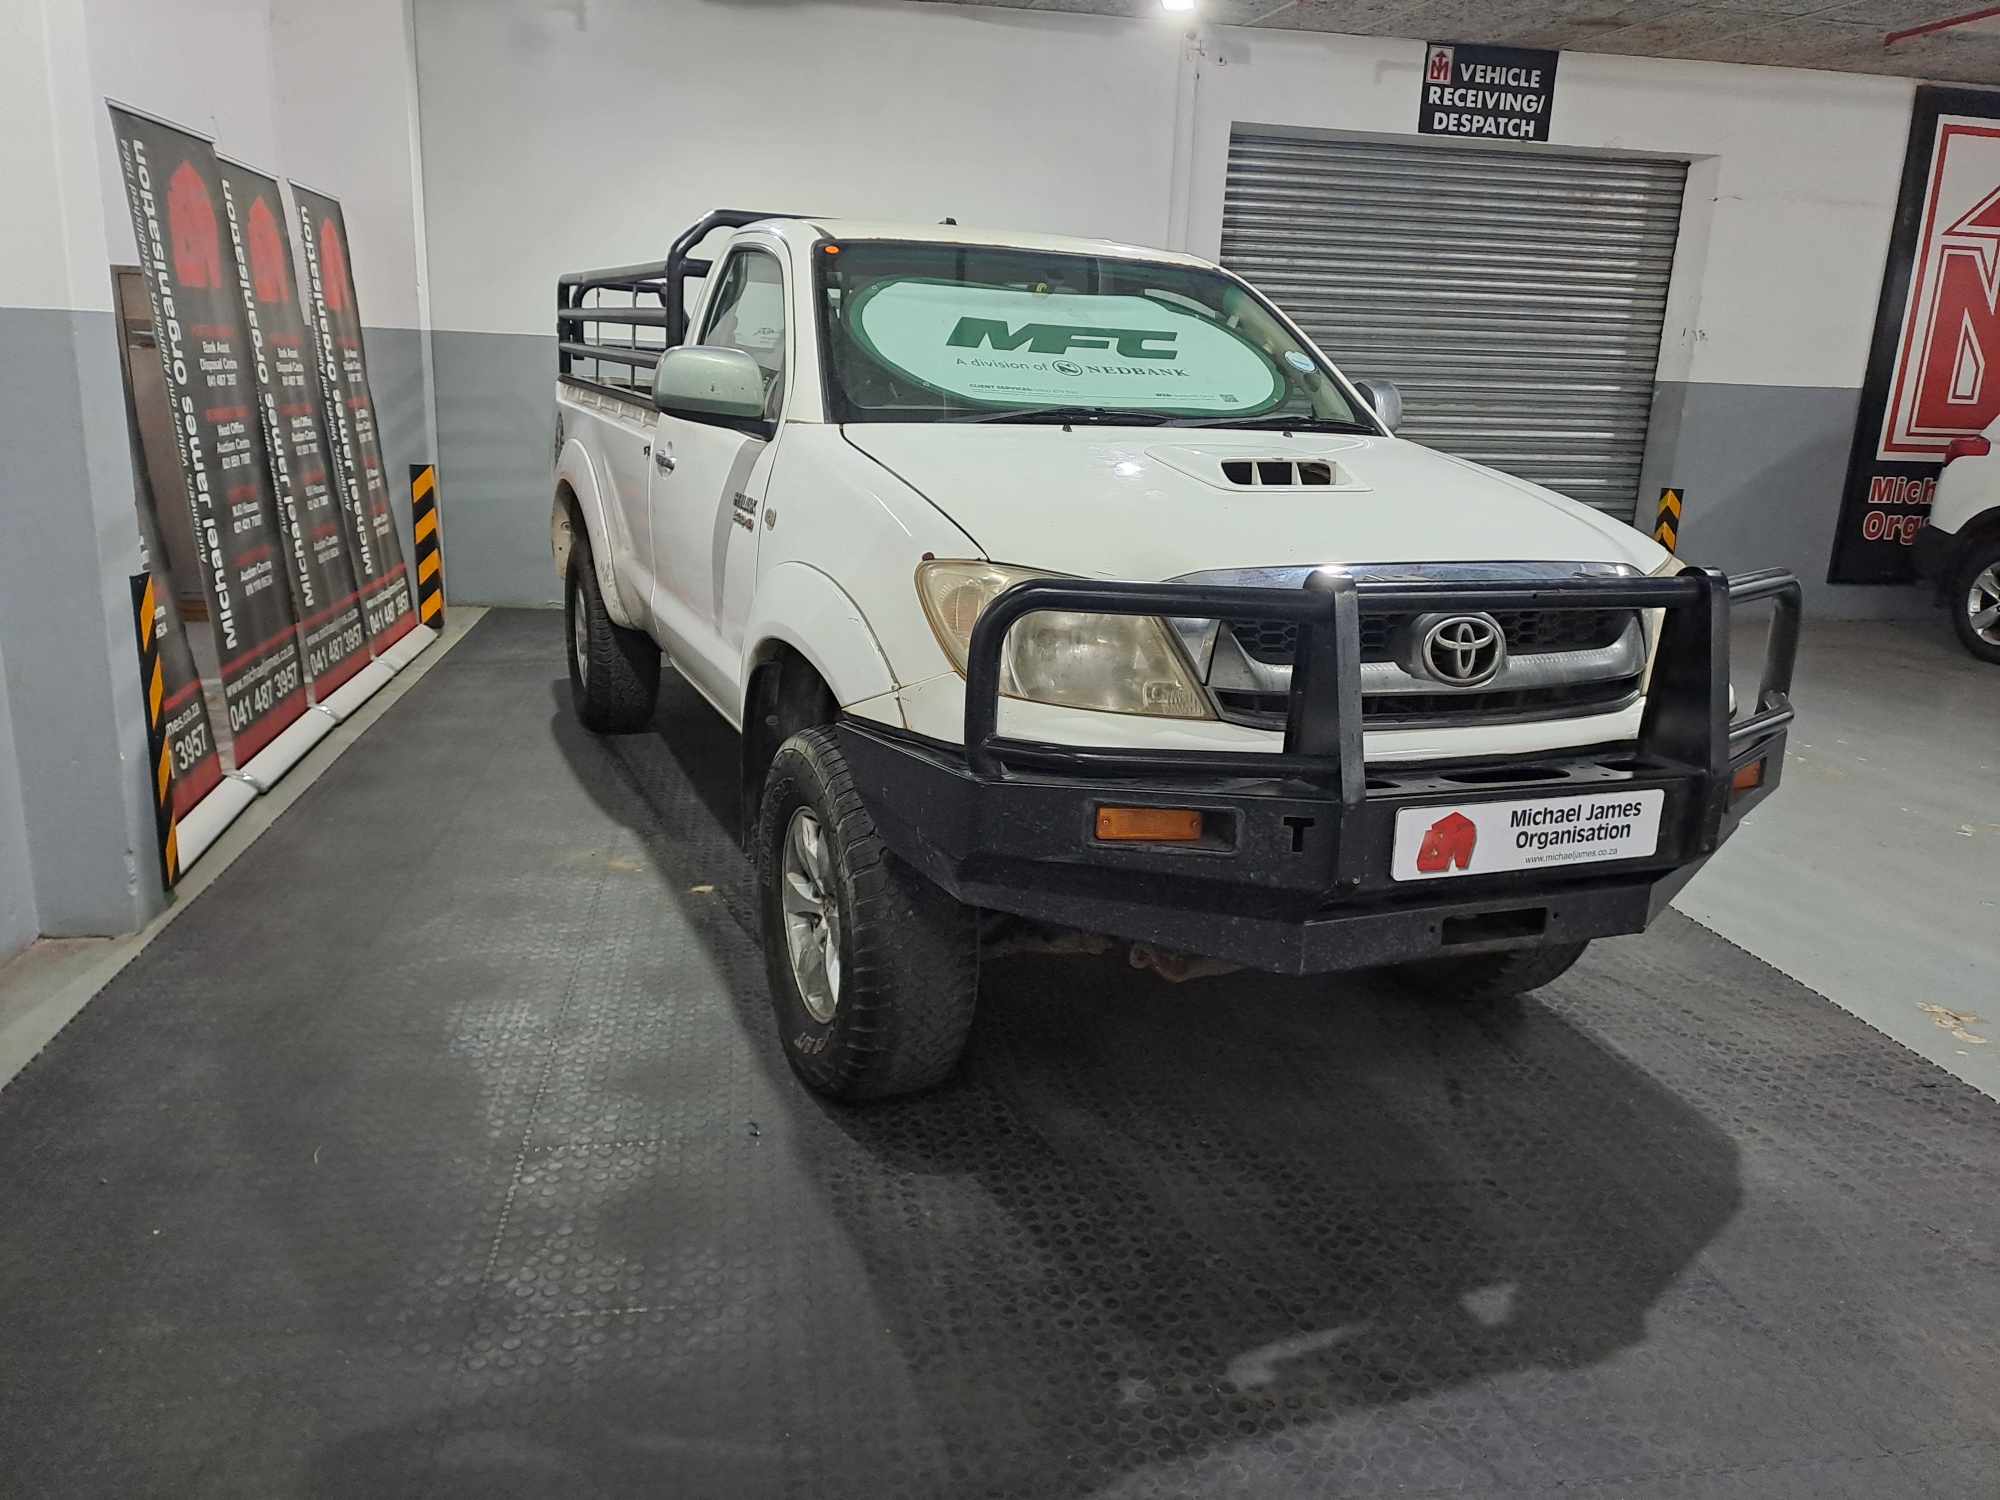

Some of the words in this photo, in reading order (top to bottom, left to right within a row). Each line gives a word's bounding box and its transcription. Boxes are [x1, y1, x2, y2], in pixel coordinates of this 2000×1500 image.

[1460, 63, 1541, 89] VEHICLE
[1428, 87, 1546, 114] RECEIVING/
[1433, 112, 1535, 138] DESPATCH
[133, 139, 187, 386] Organisation
[945, 316, 1178, 360] MFC
[956, 357, 967, 366] A
[971, 358, 1030, 370] division
[1033, 361, 1048, 371] of
[1085, 365, 1191, 377] NEDBANK
[181, 396, 212, 509] James
[264, 392, 291, 488] James
[202, 518, 238, 649] Michael
[309, 647, 328, 676] 041
[328, 635, 344, 663] 487
[343, 623, 363, 654] 3957
[230, 696, 253, 732] 041
[253, 679, 274, 713] 487
[273, 661, 299, 698] 3957
[175, 722, 208, 770] 3957
[1510, 810, 1581, 829] Michael
[1585, 801, 1642, 821] James
[1515, 820, 1632, 850] Organisation
[1524, 846, 1618, 865] www.michaeljames.co.za
